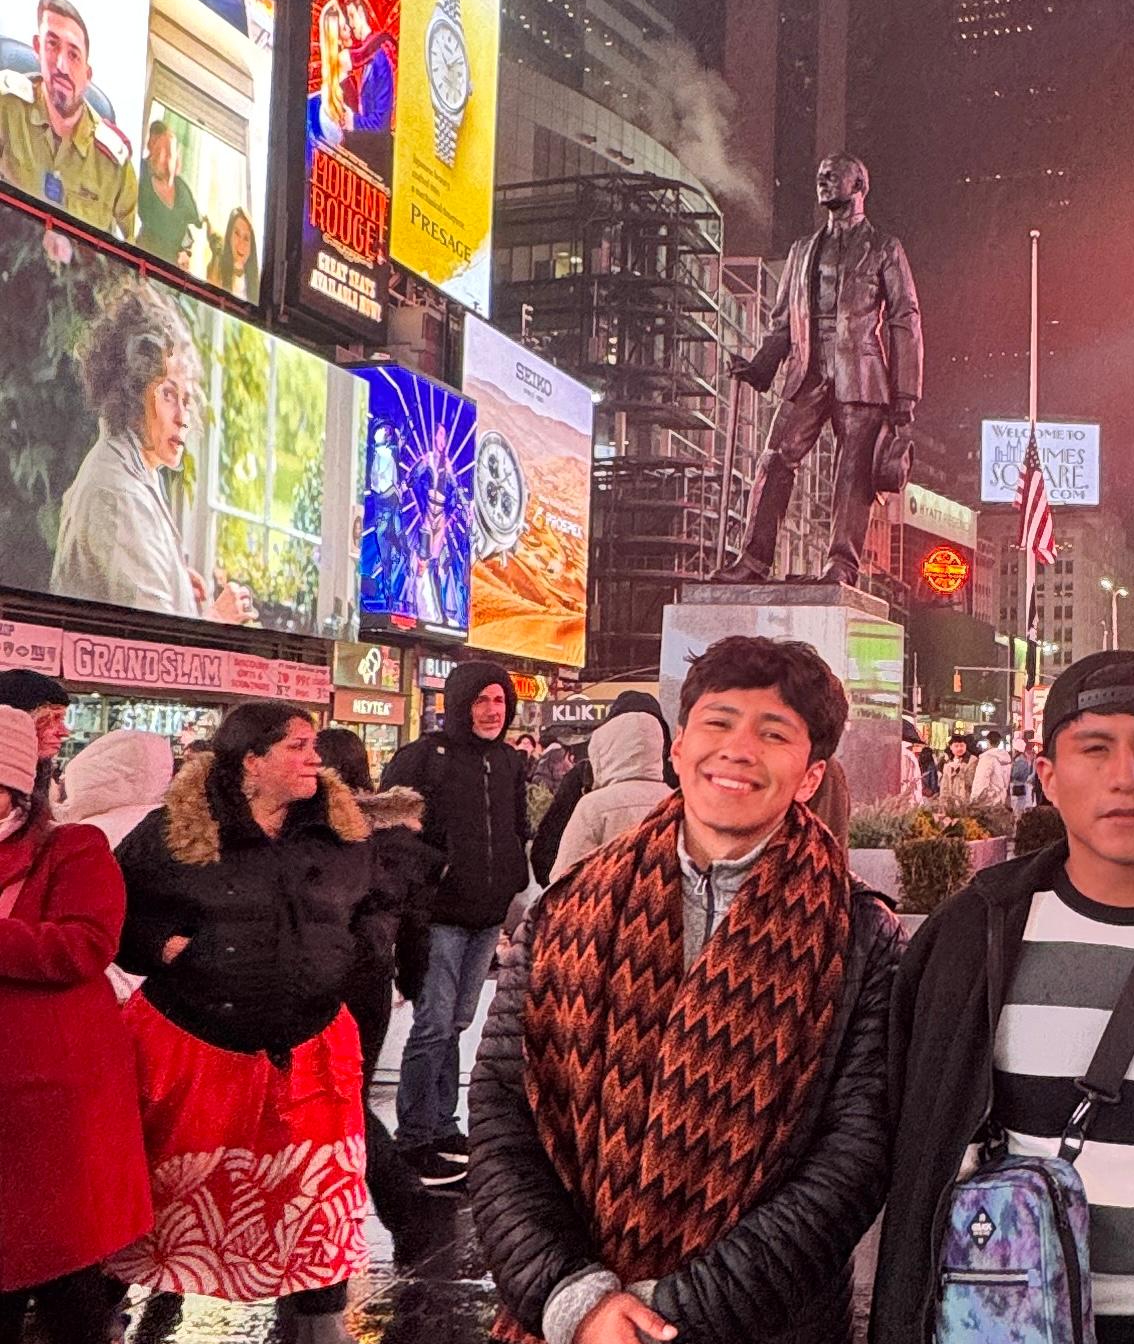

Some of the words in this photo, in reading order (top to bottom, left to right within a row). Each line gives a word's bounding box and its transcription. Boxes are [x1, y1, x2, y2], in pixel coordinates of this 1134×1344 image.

[312, 150, 382, 223] MOULIN
[410, 203, 472, 262] PRESAGE
[516, 361, 553, 398] SEIKO
[1067, 430, 1086, 441] TO
[1040, 447, 1086, 465] IMES
[990, 462, 1089, 490] SQARE
[73, 638, 160, 682] GRAND
[160, 648, 222, 688] SLAM
